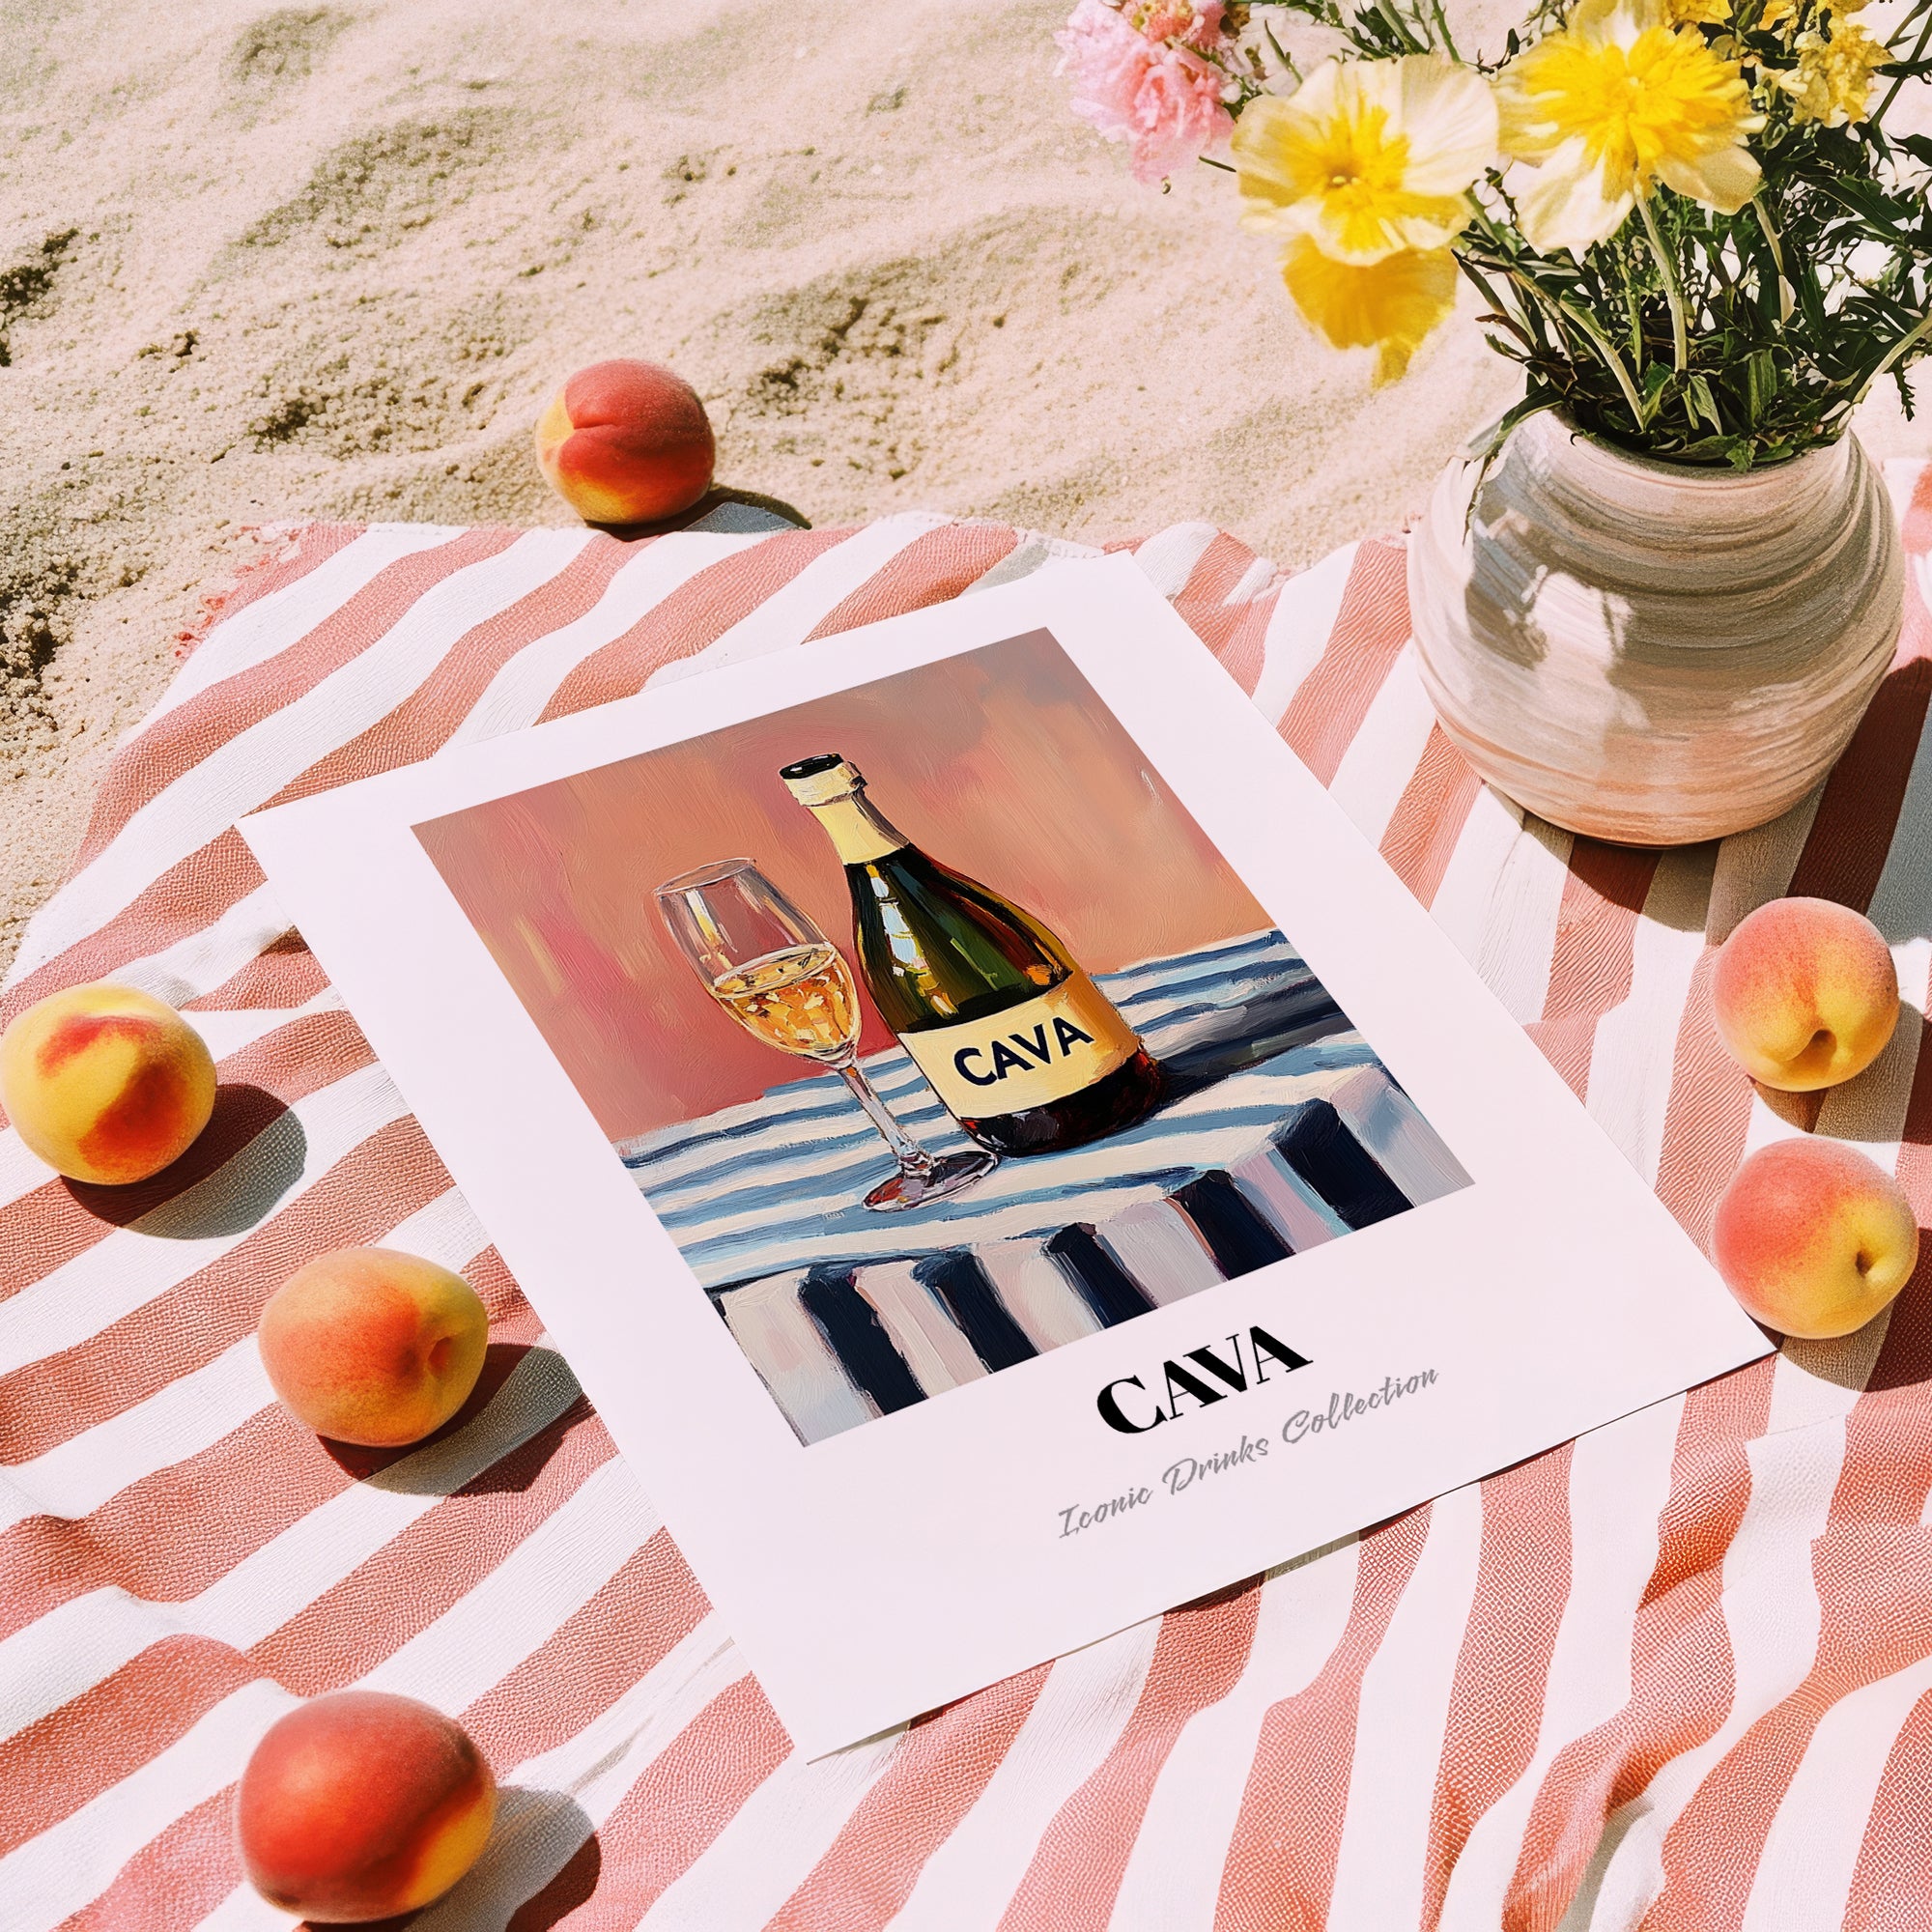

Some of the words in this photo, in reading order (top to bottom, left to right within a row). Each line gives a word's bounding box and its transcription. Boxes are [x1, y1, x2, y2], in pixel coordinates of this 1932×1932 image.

[953, 1016, 1094, 1086] CAVA
[1096, 1325, 1314, 1435] CAVA
[1058, 1486, 1153, 1539] Iconic
[1161, 1435, 1269, 1496] Drinks
[1281, 1368, 1439, 1445] Collection
